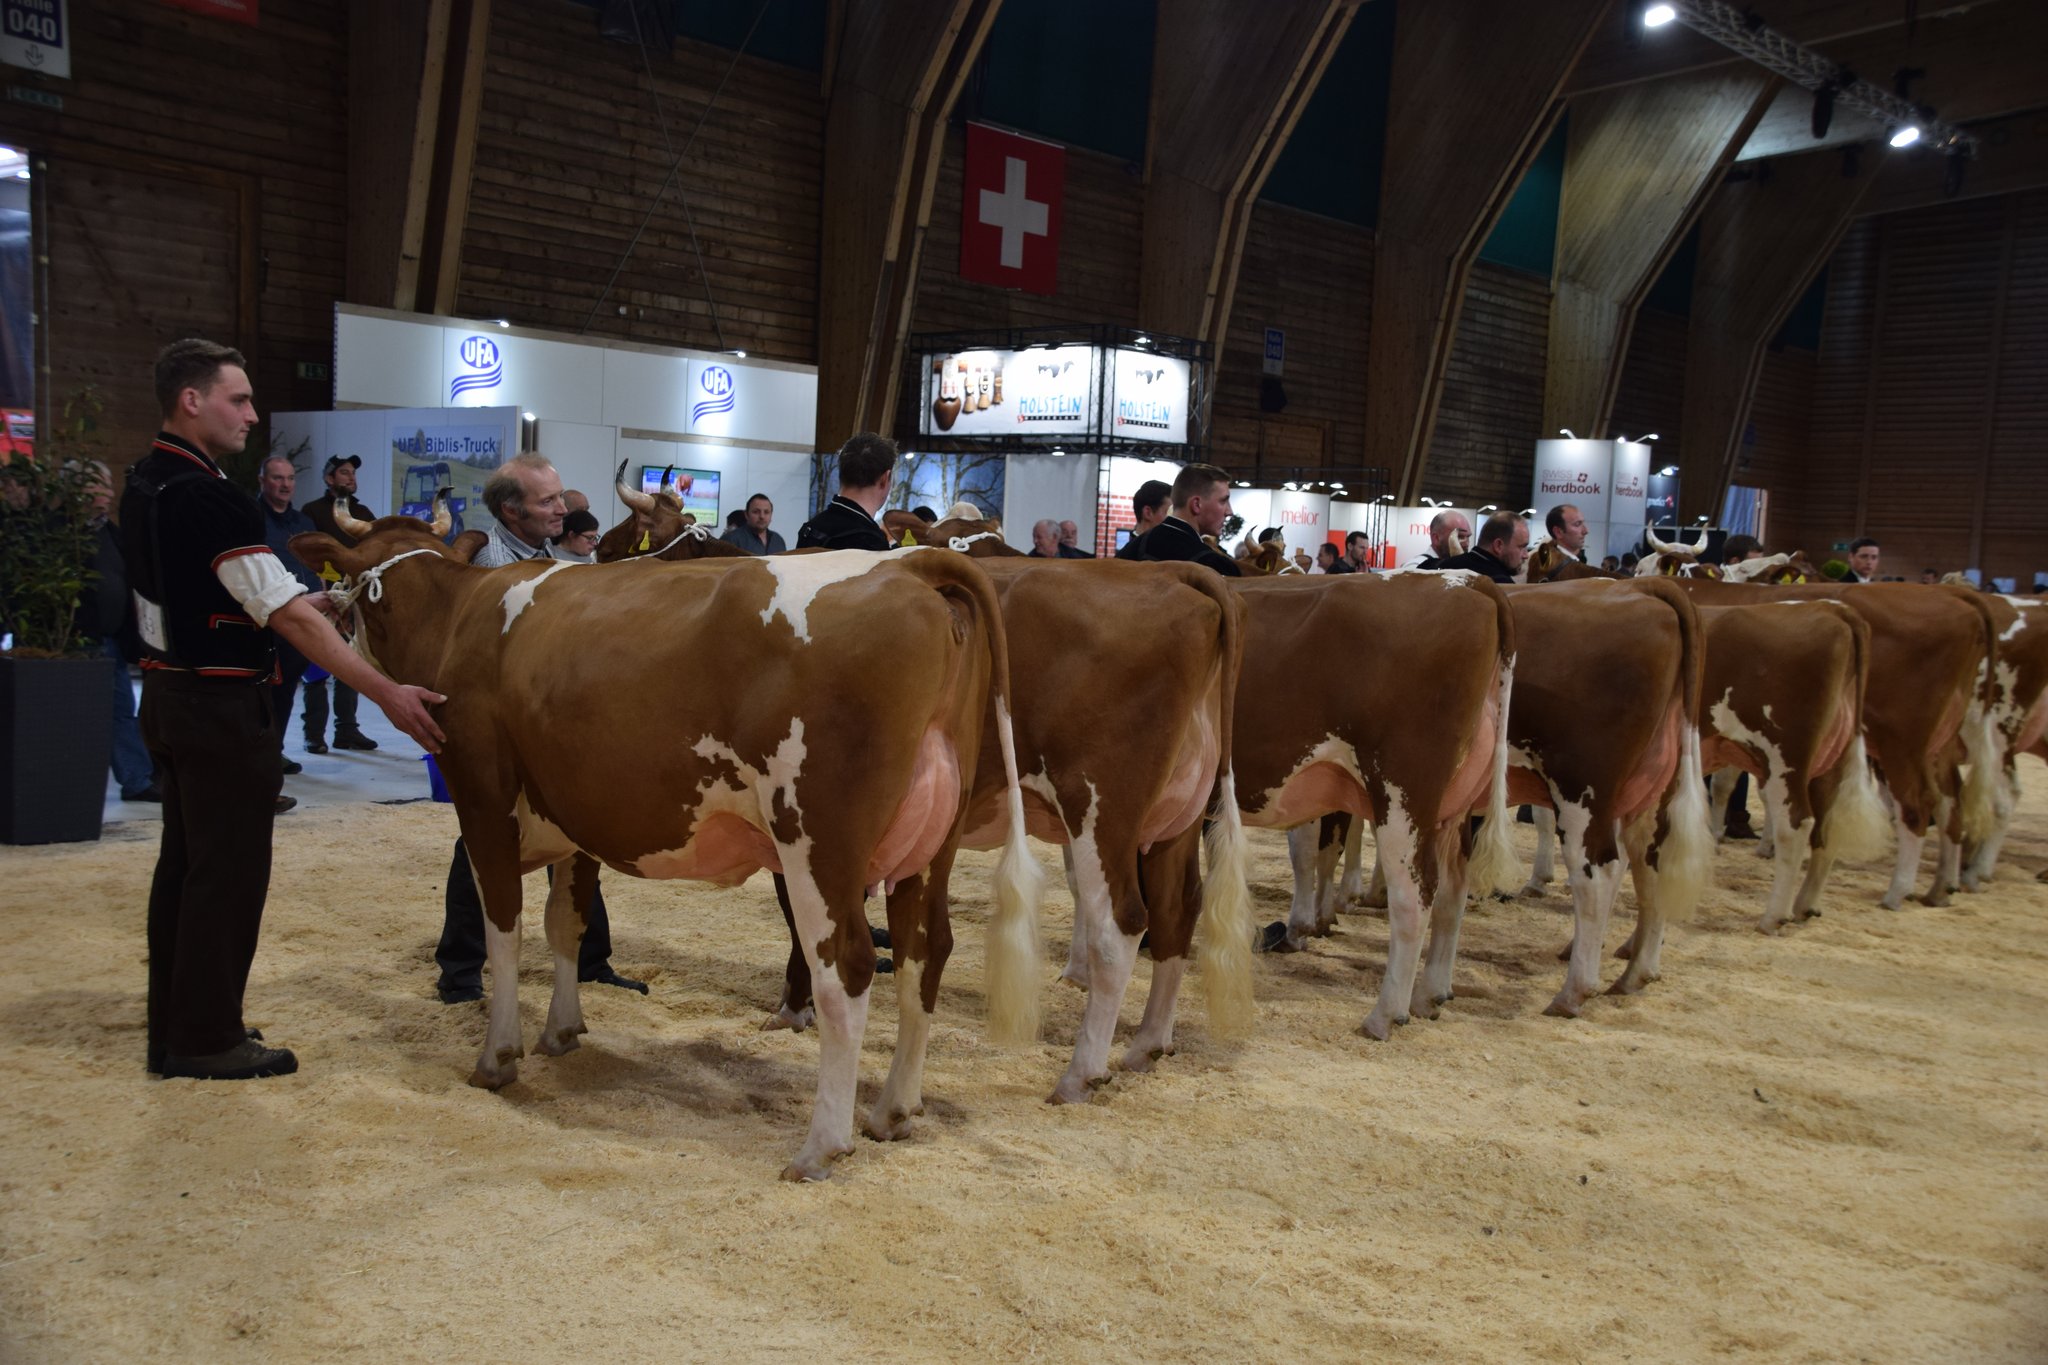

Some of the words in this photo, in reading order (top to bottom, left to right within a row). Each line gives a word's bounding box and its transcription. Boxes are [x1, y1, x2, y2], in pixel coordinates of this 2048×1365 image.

[9, 8, 57, 42] 040
[464, 337, 495, 368] UFA
[704, 367, 729, 395] UFA
[1019, 394, 1082, 413] HOLSTEIN
[1119, 399, 1171, 421] HOLSTEIN
[398, 437, 421, 453] UFA
[425, 437, 496, 454] Biblis-Truck
[1541, 482, 1601, 495] herdbook
[1615, 484, 1643, 498] herdbook
[1281, 505, 1319, 525] melior
